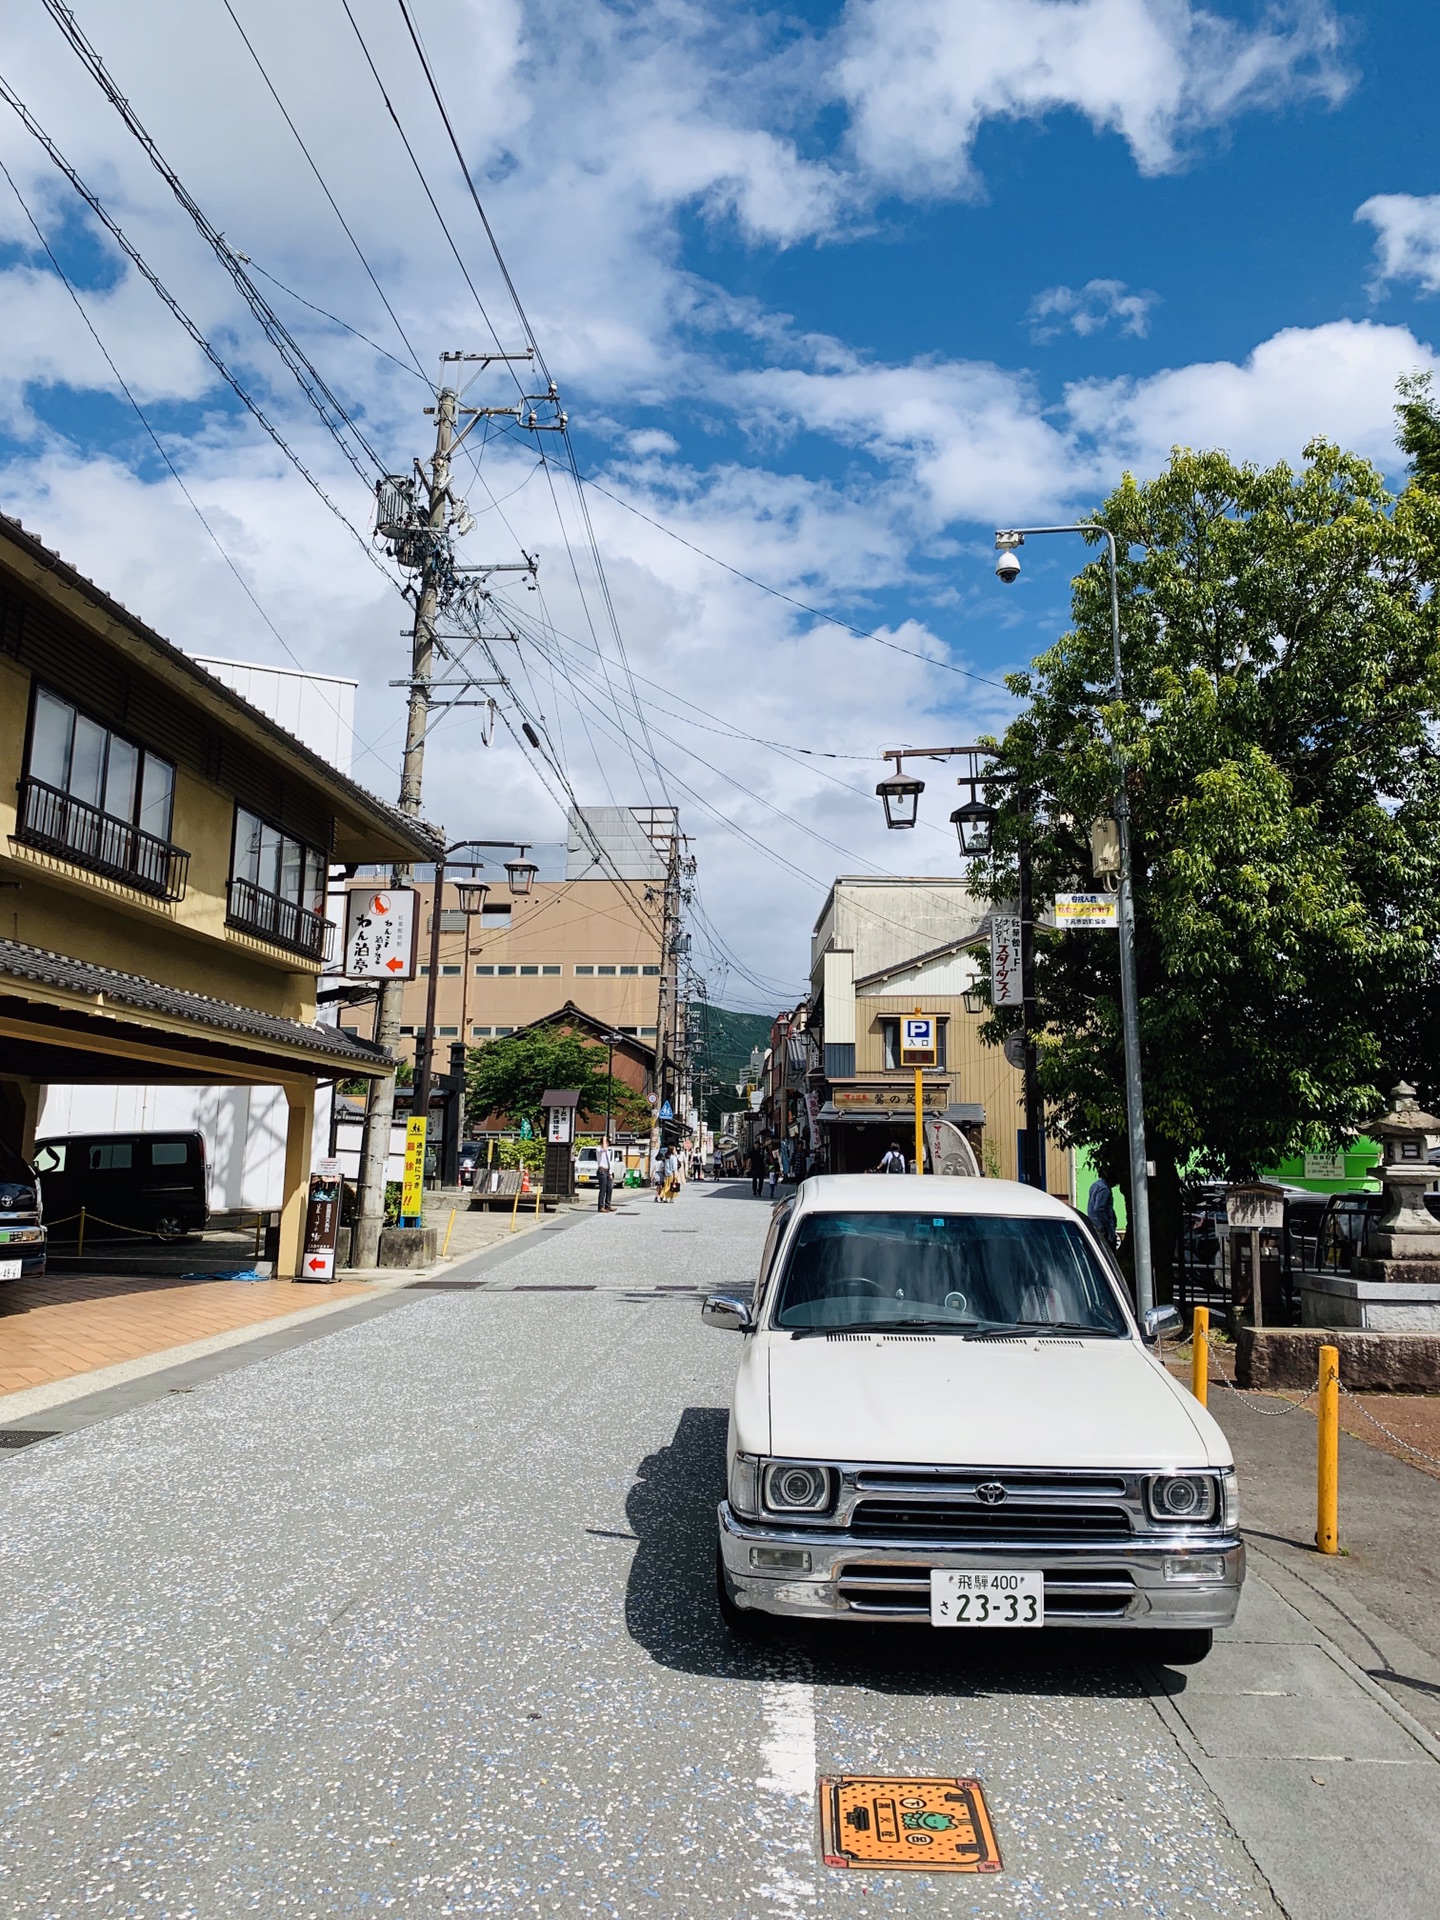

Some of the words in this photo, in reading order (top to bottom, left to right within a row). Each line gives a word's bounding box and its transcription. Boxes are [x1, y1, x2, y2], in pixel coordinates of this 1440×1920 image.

[994, 918, 1002, 943] シアター
[1002, 918, 1010, 943] ナイト
[353, 914, 372, 974] わん泊亭
[910, 1021, 927, 1036] P
[413, 1142, 423, 1189] 通学路につき
[991, 1575, 1018, 1590] 400
[940, 1600, 949, 1616] さ
[956, 1594, 1037, 1623] 23-33
